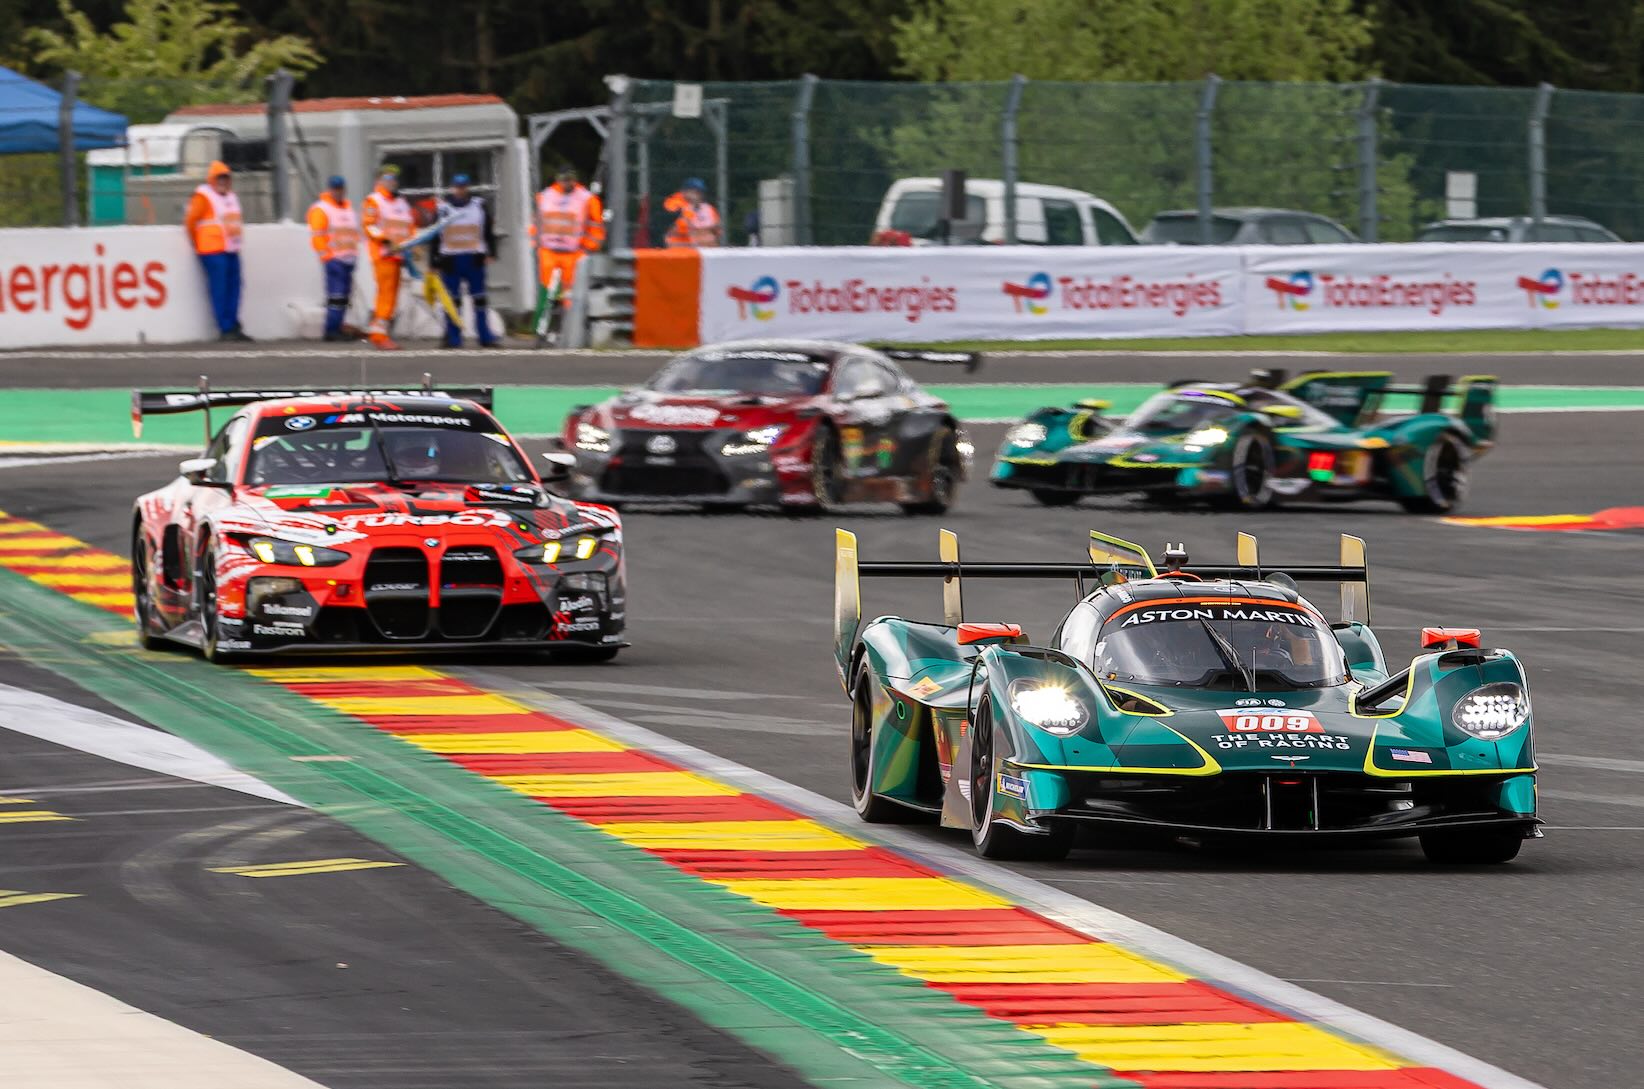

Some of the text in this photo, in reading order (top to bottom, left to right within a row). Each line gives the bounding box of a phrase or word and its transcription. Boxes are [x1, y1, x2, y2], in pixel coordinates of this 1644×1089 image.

[0, 243, 168, 330] ergies
[1056, 273, 1222, 317] TotalEnergies
[1319, 272, 1477, 316] TotalEnergies
[785, 275, 957, 322] TotalEnergies
[369, 413, 471, 427] Motorsport
[1120, 609, 1321, 630] ASTON MARTIN
[1235, 716, 1310, 731] 009
[1211, 733, 1349, 743] THE HEART
[1218, 740, 1351, 750] OF RACING
